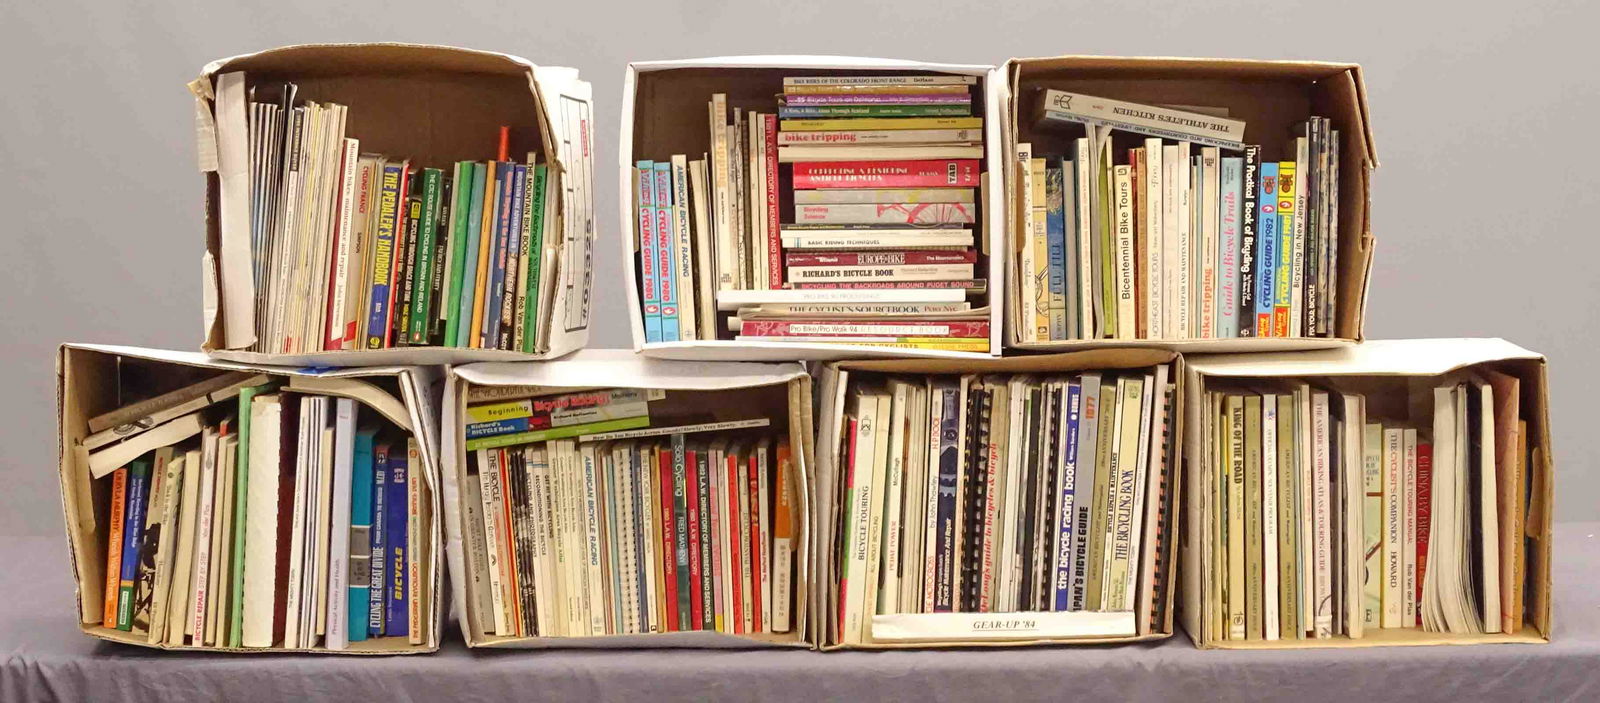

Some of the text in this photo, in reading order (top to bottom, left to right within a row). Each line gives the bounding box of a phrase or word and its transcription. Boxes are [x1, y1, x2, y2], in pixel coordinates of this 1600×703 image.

[1113, 107, 1230, 133] THE ATHLETE'S KITCHEN
[784, 132, 857, 143] bike tripping
[347, 142, 356, 175] Mountain
[1246, 147, 1256, 164] The
[359, 166, 369, 214] CYCLING FRANCE
[677, 166, 686, 208] AMERICAN
[766, 156, 774, 193] DIRECTORY
[1244, 165, 1255, 198] Practical
[524, 177, 533, 215] MOUNTAIN
[768, 195, 775, 203] OF
[1297, 195, 1305, 220] Jersey
[342, 197, 351, 242] maintenance
[425, 211, 433, 226] GUIDE
[641, 208, 651, 247] CYCLING
[679, 210, 688, 244] BICYCLE
[1244, 201, 1254, 223] Book
[374, 171, 397, 286] THE PEDALER'S HANDBOOK
[421, 234, 430, 254] CYCLING
[658, 210, 668, 248] CYCLING
[1119, 182, 1131, 300] Bicentennial Bike Tours
[1244, 225, 1254, 236] of
[521, 235, 529, 256] BOOK
[1223, 191, 1236, 317] Guide to Bicycle Trails
[1241, 237, 1254, 272] Bicycling
[338, 257, 346, 278] repair
[418, 261, 427, 280] BRITAIN
[644, 248, 653, 276] GUIDE
[660, 250, 669, 278] GUIDE
[802, 270, 841, 278] RICHARD'S
[843, 269, 873, 278] BICYCLE
[875, 269, 894, 277] BOOK
[1262, 217, 1274, 308] CYCLING GUIDE 1982
[1293, 251, 1303, 288] Bicycling
[417, 280, 425, 291] AND
[645, 277, 654, 300] 1980
[662, 279, 670, 302] 1980
[802, 282, 837, 290] BICYCLING
[854, 282, 894, 290] BACKROADS
[897, 281, 924, 289] AROUND
[951, 280, 974, 288] SOUND
[415, 292, 424, 313] IRELAND
[1202, 268, 1212, 339] bike tripping
[802, 325, 830, 333] Bike/Pro
[488, 405, 529, 416] Beginning
[674, 444, 683, 462] Solo
[1233, 407, 1243, 484] KING OF THE ROAD
[489, 455, 498, 471] THE
[1417, 455, 1430, 493] CHINA
[490, 471, 500, 502] BICYCLE
[673, 463, 684, 497] Cycling
[1121, 470, 1134, 494] BOOK
[584, 456, 598, 566] AMERICAN BICYCLE RACING
[700, 497, 708, 533] DIRECTORY
[984, 487, 996, 527] bicycles
[1116, 496, 1132, 542] BICYCLING
[1390, 434, 1398, 588] THE CYCLIST'S COMPANION HOWARD
[1417, 494, 1429, 513] BY
[677, 516, 686, 533] FRED
[702, 533, 709, 542] OF
[858, 485, 869, 561] BICYCLE TOURING
[984, 527, 992, 537] to
[1057, 462, 1075, 590] the bicycle racing book
[1417, 514, 1428, 544] BIKE
[982, 538, 993, 567] guide
[1076, 507, 1089, 576] BICYCLE GUIDE
[1114, 544, 1128, 561] THE
[394, 546, 403, 601] BICYCLE
[702, 543, 710, 575] MEMBERS
[370, 546, 383, 629] CYCLING THE GREAT DIVIDE
[194, 590, 204, 641] BICYCLE REPAIR
[704, 591, 712, 623] SERVICES
[972, 620, 1036, 630] GEAR-UP '84
